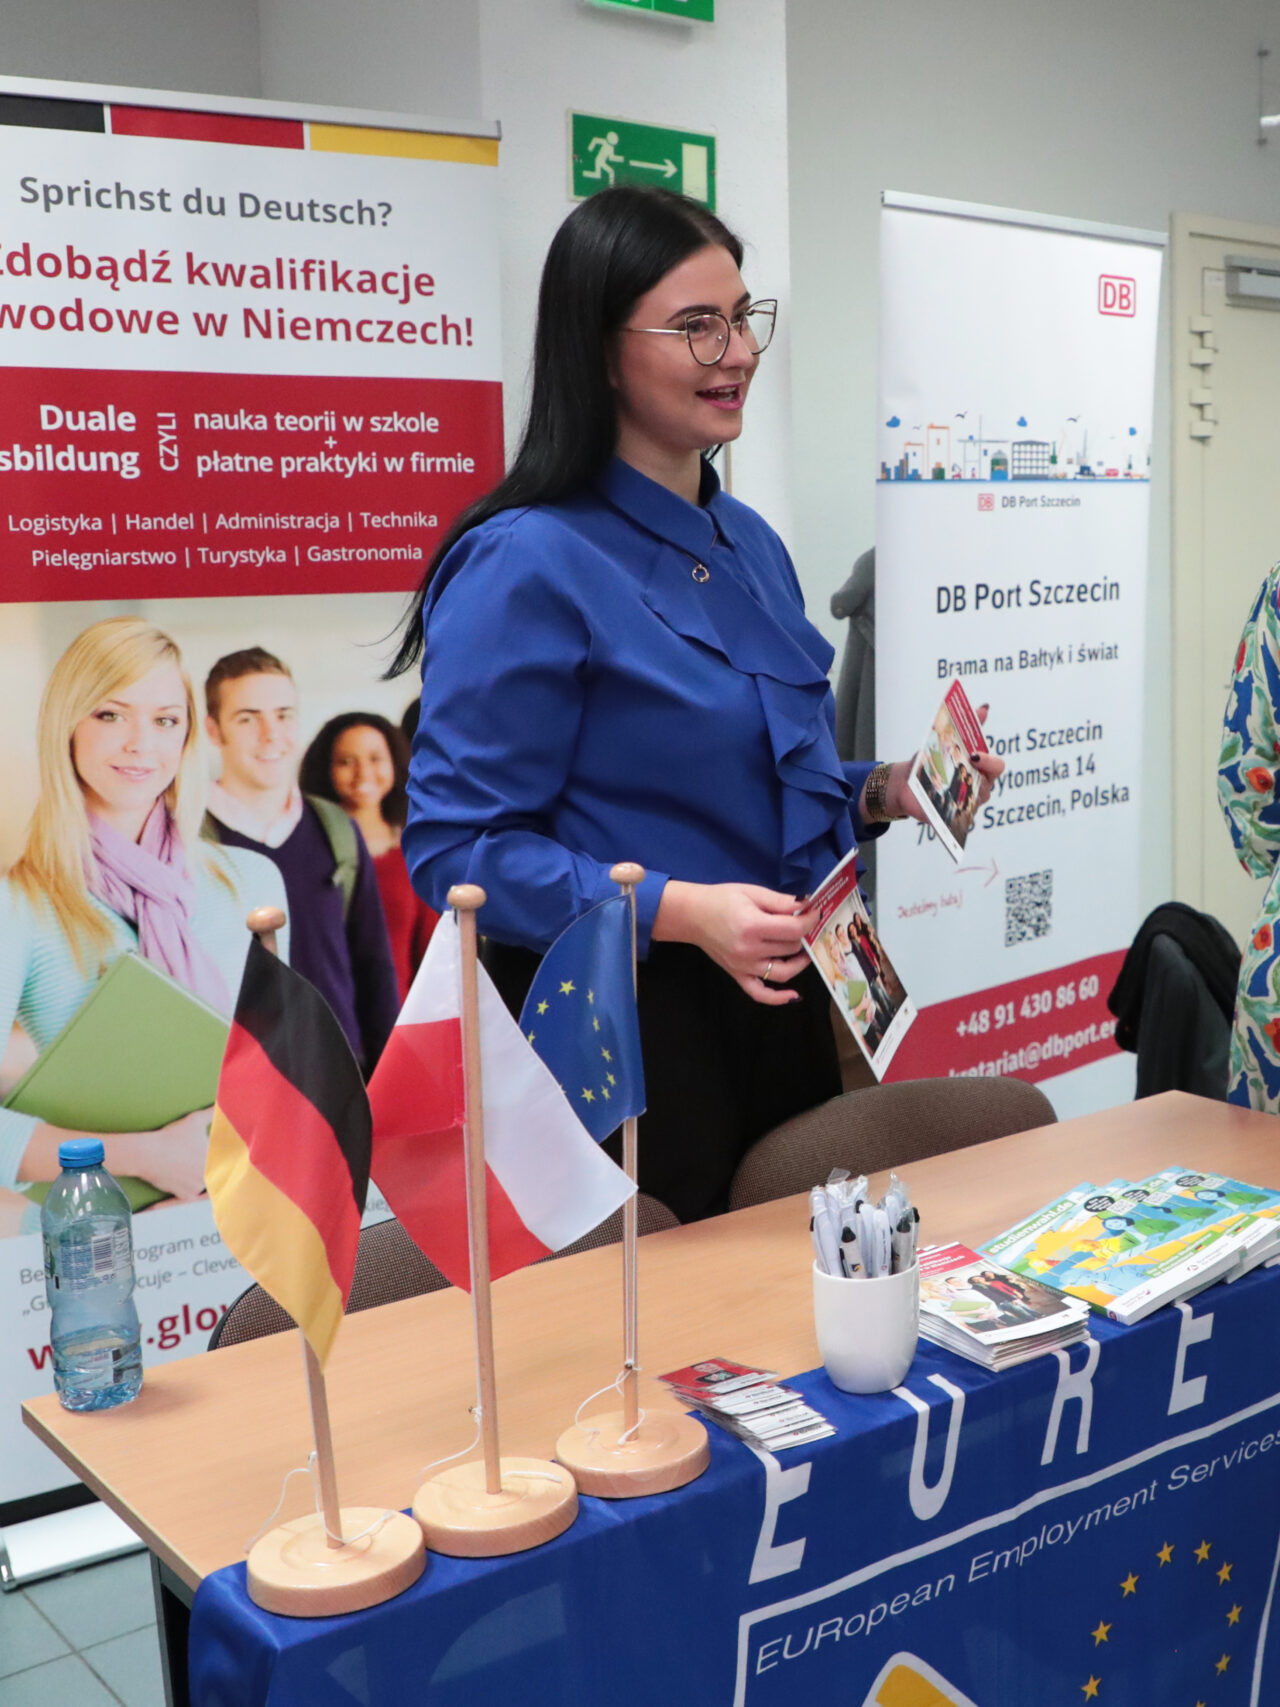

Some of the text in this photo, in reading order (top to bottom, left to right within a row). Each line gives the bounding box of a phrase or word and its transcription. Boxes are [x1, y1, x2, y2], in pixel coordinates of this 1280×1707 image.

[20, 176, 393, 226] Sprichst du Deutsch?
[0, 242, 436, 304] dobądź kwalifikacje
[1103, 281, 1132, 310] DB
[193, 311, 228, 337] w
[243, 308, 474, 347] Niemczech!
[40, 404, 136, 432] Duale
[193, 412, 439, 434] nauka teorii w szkole
[157, 412, 179, 471] CZYLI
[196, 452, 475, 478] płatne praktyki w firmie
[1001, 496, 1016, 508] DB
[1019, 495, 1038, 508] Port
[1040, 495, 1081, 508] Szczecin
[8, 513, 103, 534] Logistyka
[126, 513, 194, 531] Handel
[216, 511, 340, 533] Administracja
[360, 511, 438, 528] Technika
[32, 549, 177, 572] Pielęgniarstwo
[198, 548, 287, 570] Turystyka
[307, 545, 423, 562] Gastronomia
[936, 576, 1120, 614] DB Port Szczecin
[938, 643, 1119, 679] Brama na Bałtyk i świat
[1026, 720, 1103, 751] Szczecin
[1075, 752, 1096, 778] 14
[983, 784, 1130, 830] Szczecin, Polska
[956, 974, 1099, 1037] +48 91 430 86 60
[131, 1237, 194, 1262] rogram
[192, 1256, 241, 1276] Cleve
[756, 1572, 956, 1676] EURopean
[967, 1480, 1158, 1584] Employment
